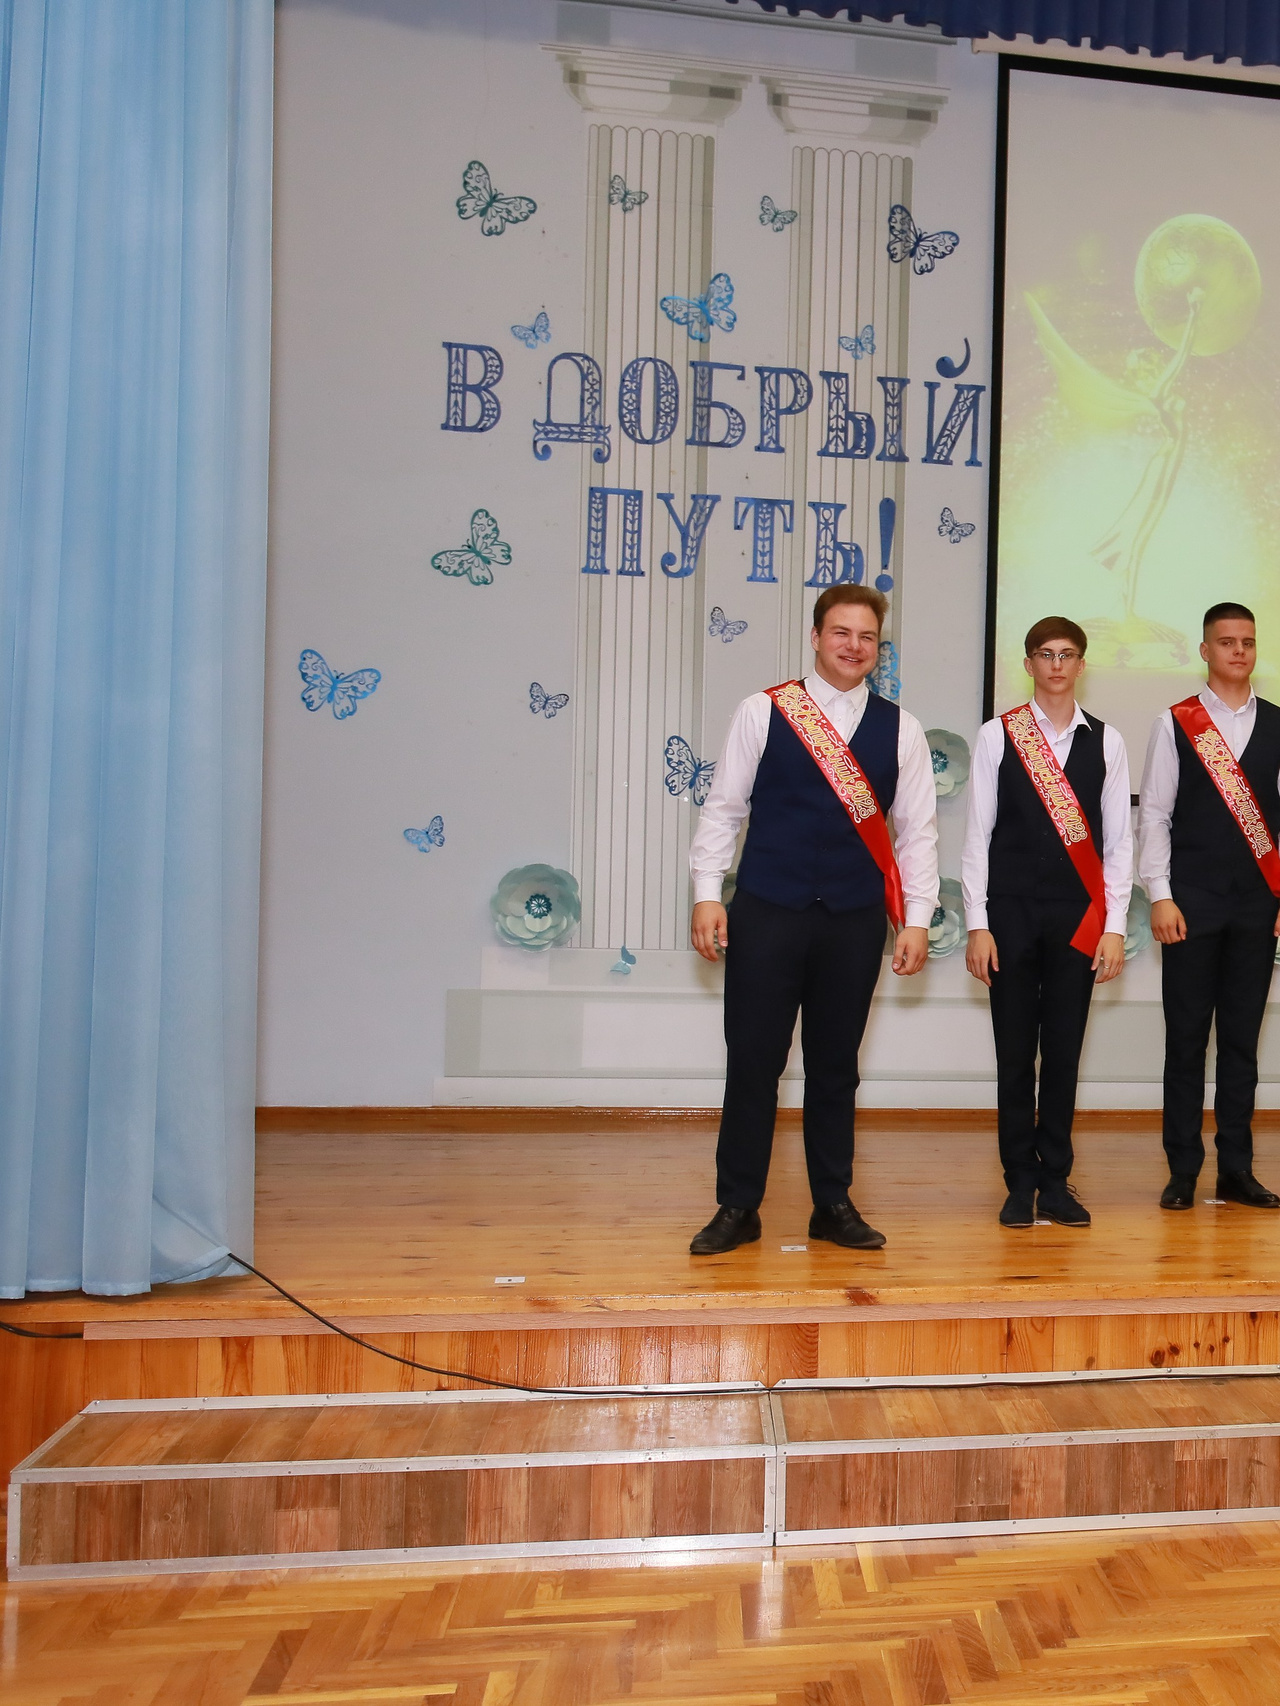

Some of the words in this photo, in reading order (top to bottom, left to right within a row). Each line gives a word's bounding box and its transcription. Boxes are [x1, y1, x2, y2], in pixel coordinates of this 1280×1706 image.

[441, 341, 504, 432] В
[533, 338, 986, 467] ДОБРЫЙ
[581, 486, 896, 593] ПУТЬ!
[844, 779, 877, 819] 2023
[1056, 806, 1087, 843] 2023
